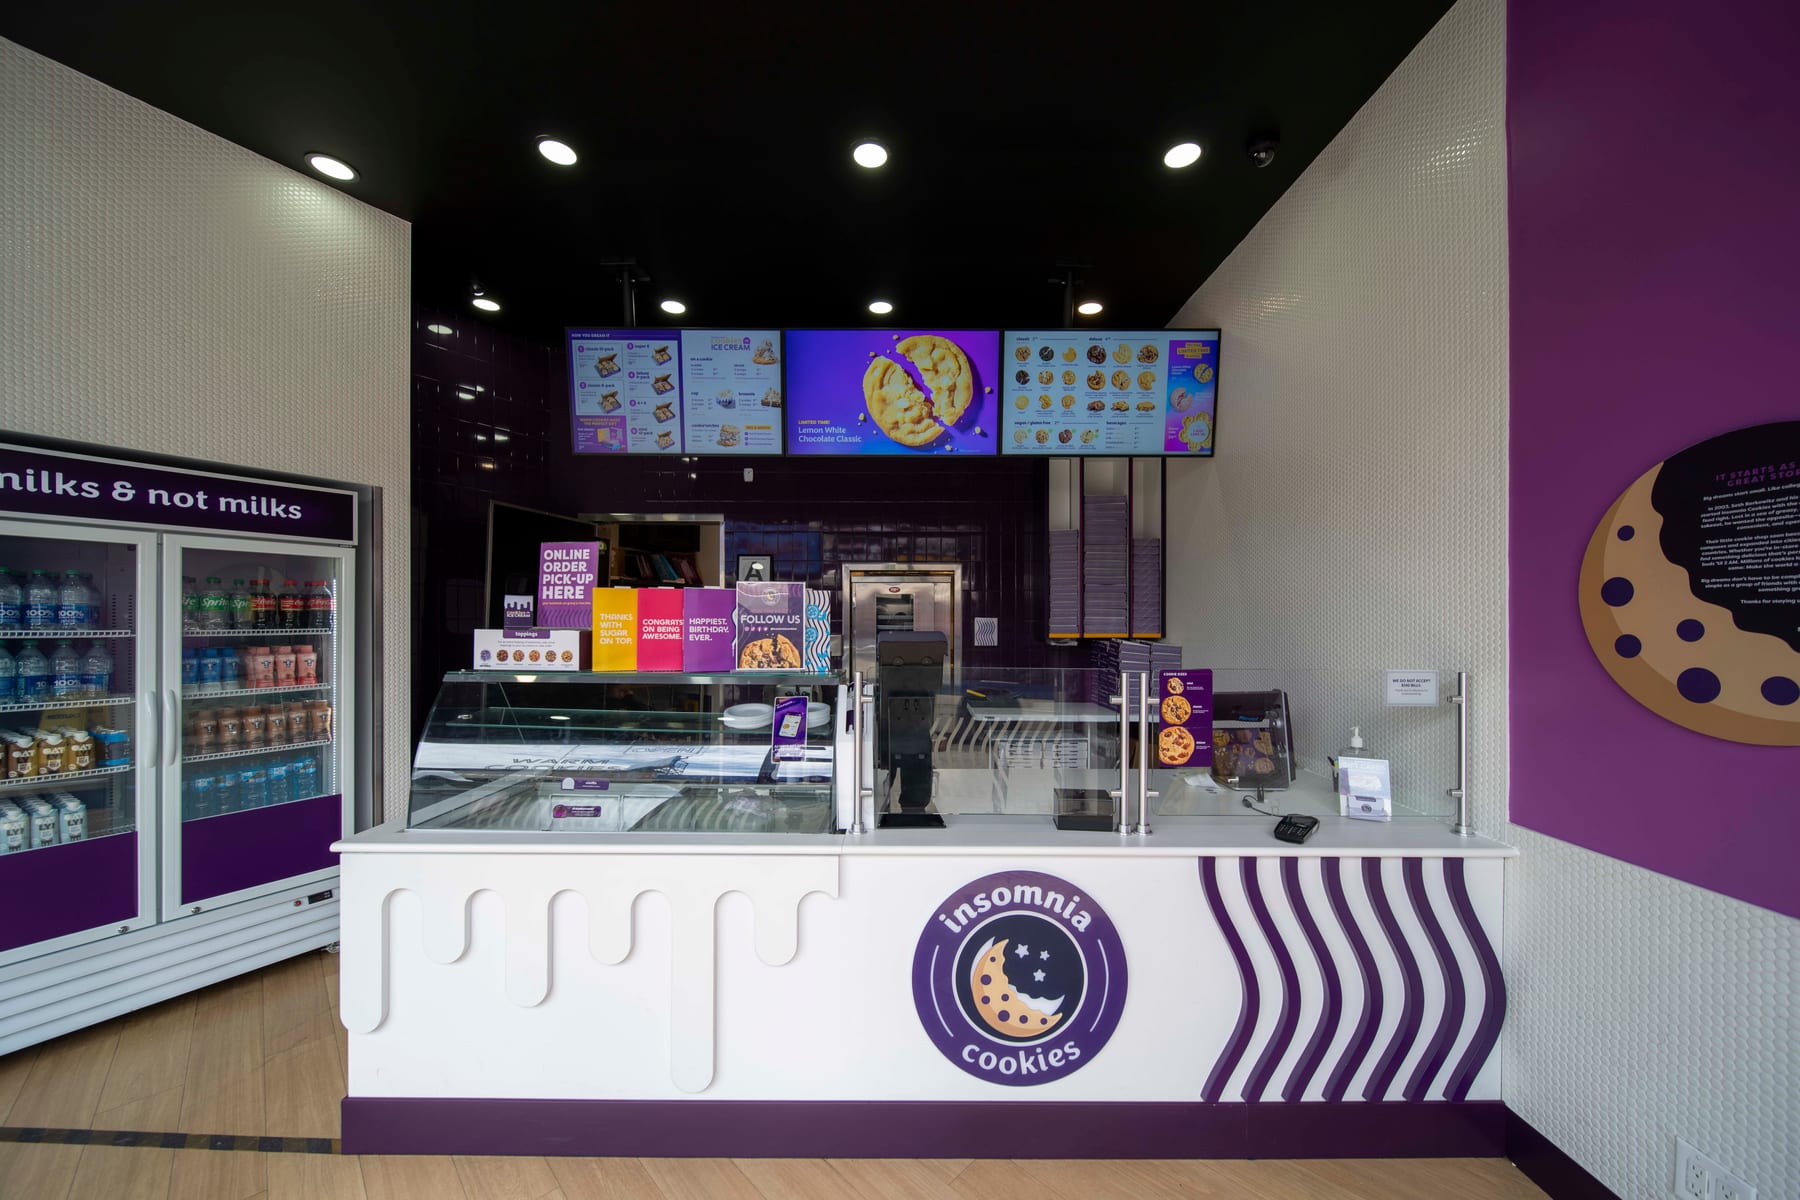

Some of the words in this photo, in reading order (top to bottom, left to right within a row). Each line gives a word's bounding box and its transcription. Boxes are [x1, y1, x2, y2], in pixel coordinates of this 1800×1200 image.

[1730, 465, 1775, 479] STARTS
[1728, 474, 1766, 487] GREAT
[112, 481, 135, 502] &
[148, 488, 208, 510] not
[219, 496, 302, 520] milks
[544, 549, 590, 560] ONLINE
[543, 561, 587, 572] ORDER
[543, 573, 594, 585] PICK-UP
[542, 586, 585, 600] HERE
[740, 615, 784, 624] FOLLOW
[787, 615, 801, 624] US
[938, 885, 1092, 933] insomnia
[961, 1041, 1081, 1075] cookies
